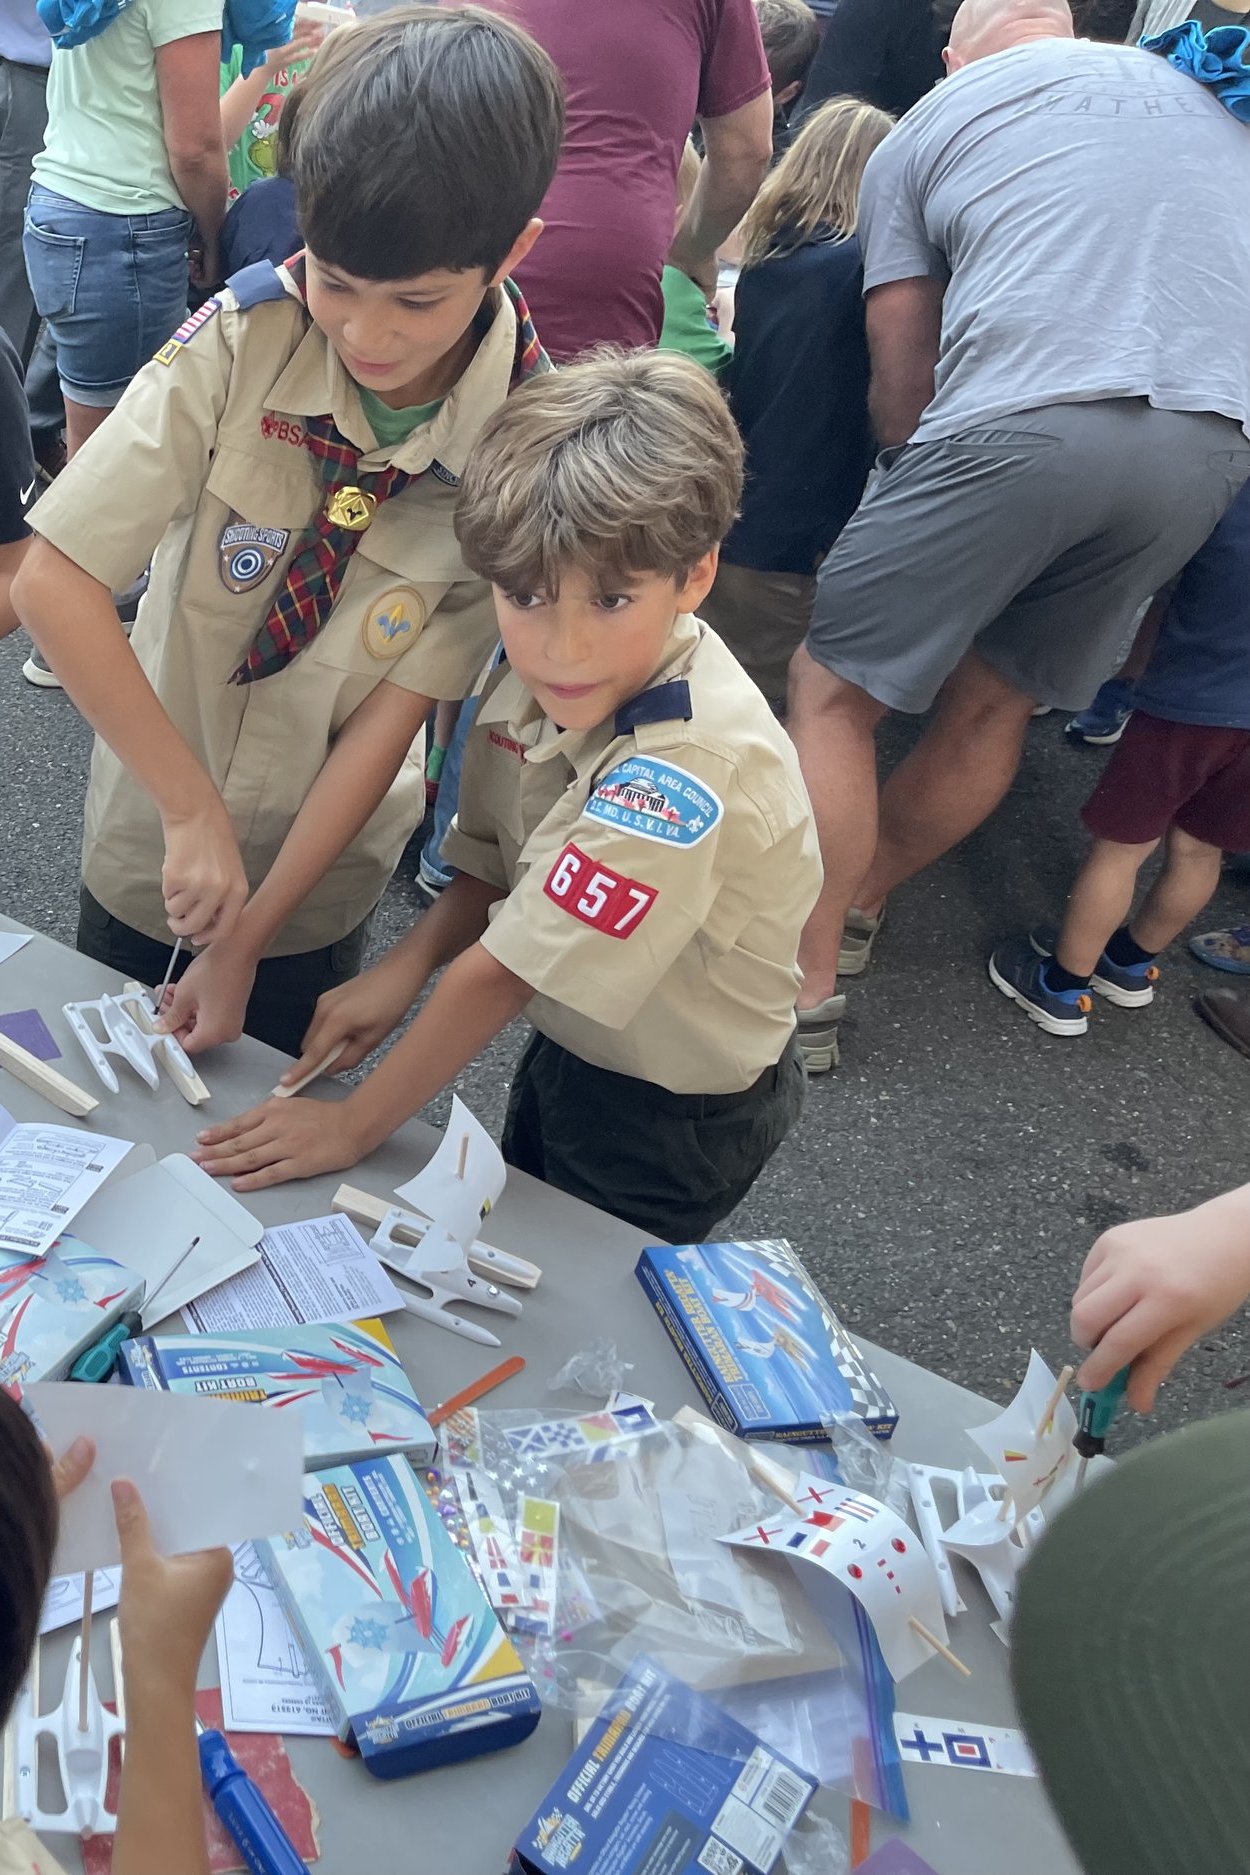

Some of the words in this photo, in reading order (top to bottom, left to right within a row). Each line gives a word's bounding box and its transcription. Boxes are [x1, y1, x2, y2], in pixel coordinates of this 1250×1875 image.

[225, 527, 259, 544] SHOOTING
[258, 528, 283, 548] SPORTS
[622, 763, 655, 780] CAPITAL
[658, 774, 683, 792] AREA
[683, 787, 714, 818] COUNCIL
[603, 803, 619, 819] MD.
[551, 853, 650, 931] 657
[467, 1278, 477, 1288] 4
[183, 1362, 228, 1375] CONTENTS
[195, 1379, 219, 1393] KIT
[220, 1376, 257, 1390] BOAT
[852, 1538, 867, 1550] 2
[405, 1711, 444, 1730] OFFICIAL
[514, 1688, 531, 1701] KIT
[566, 1757, 601, 1804] OFFICIAL
[592, 1707, 632, 1763] TRIMARAN
[541, 1813, 582, 1866] RAINGUTTER
